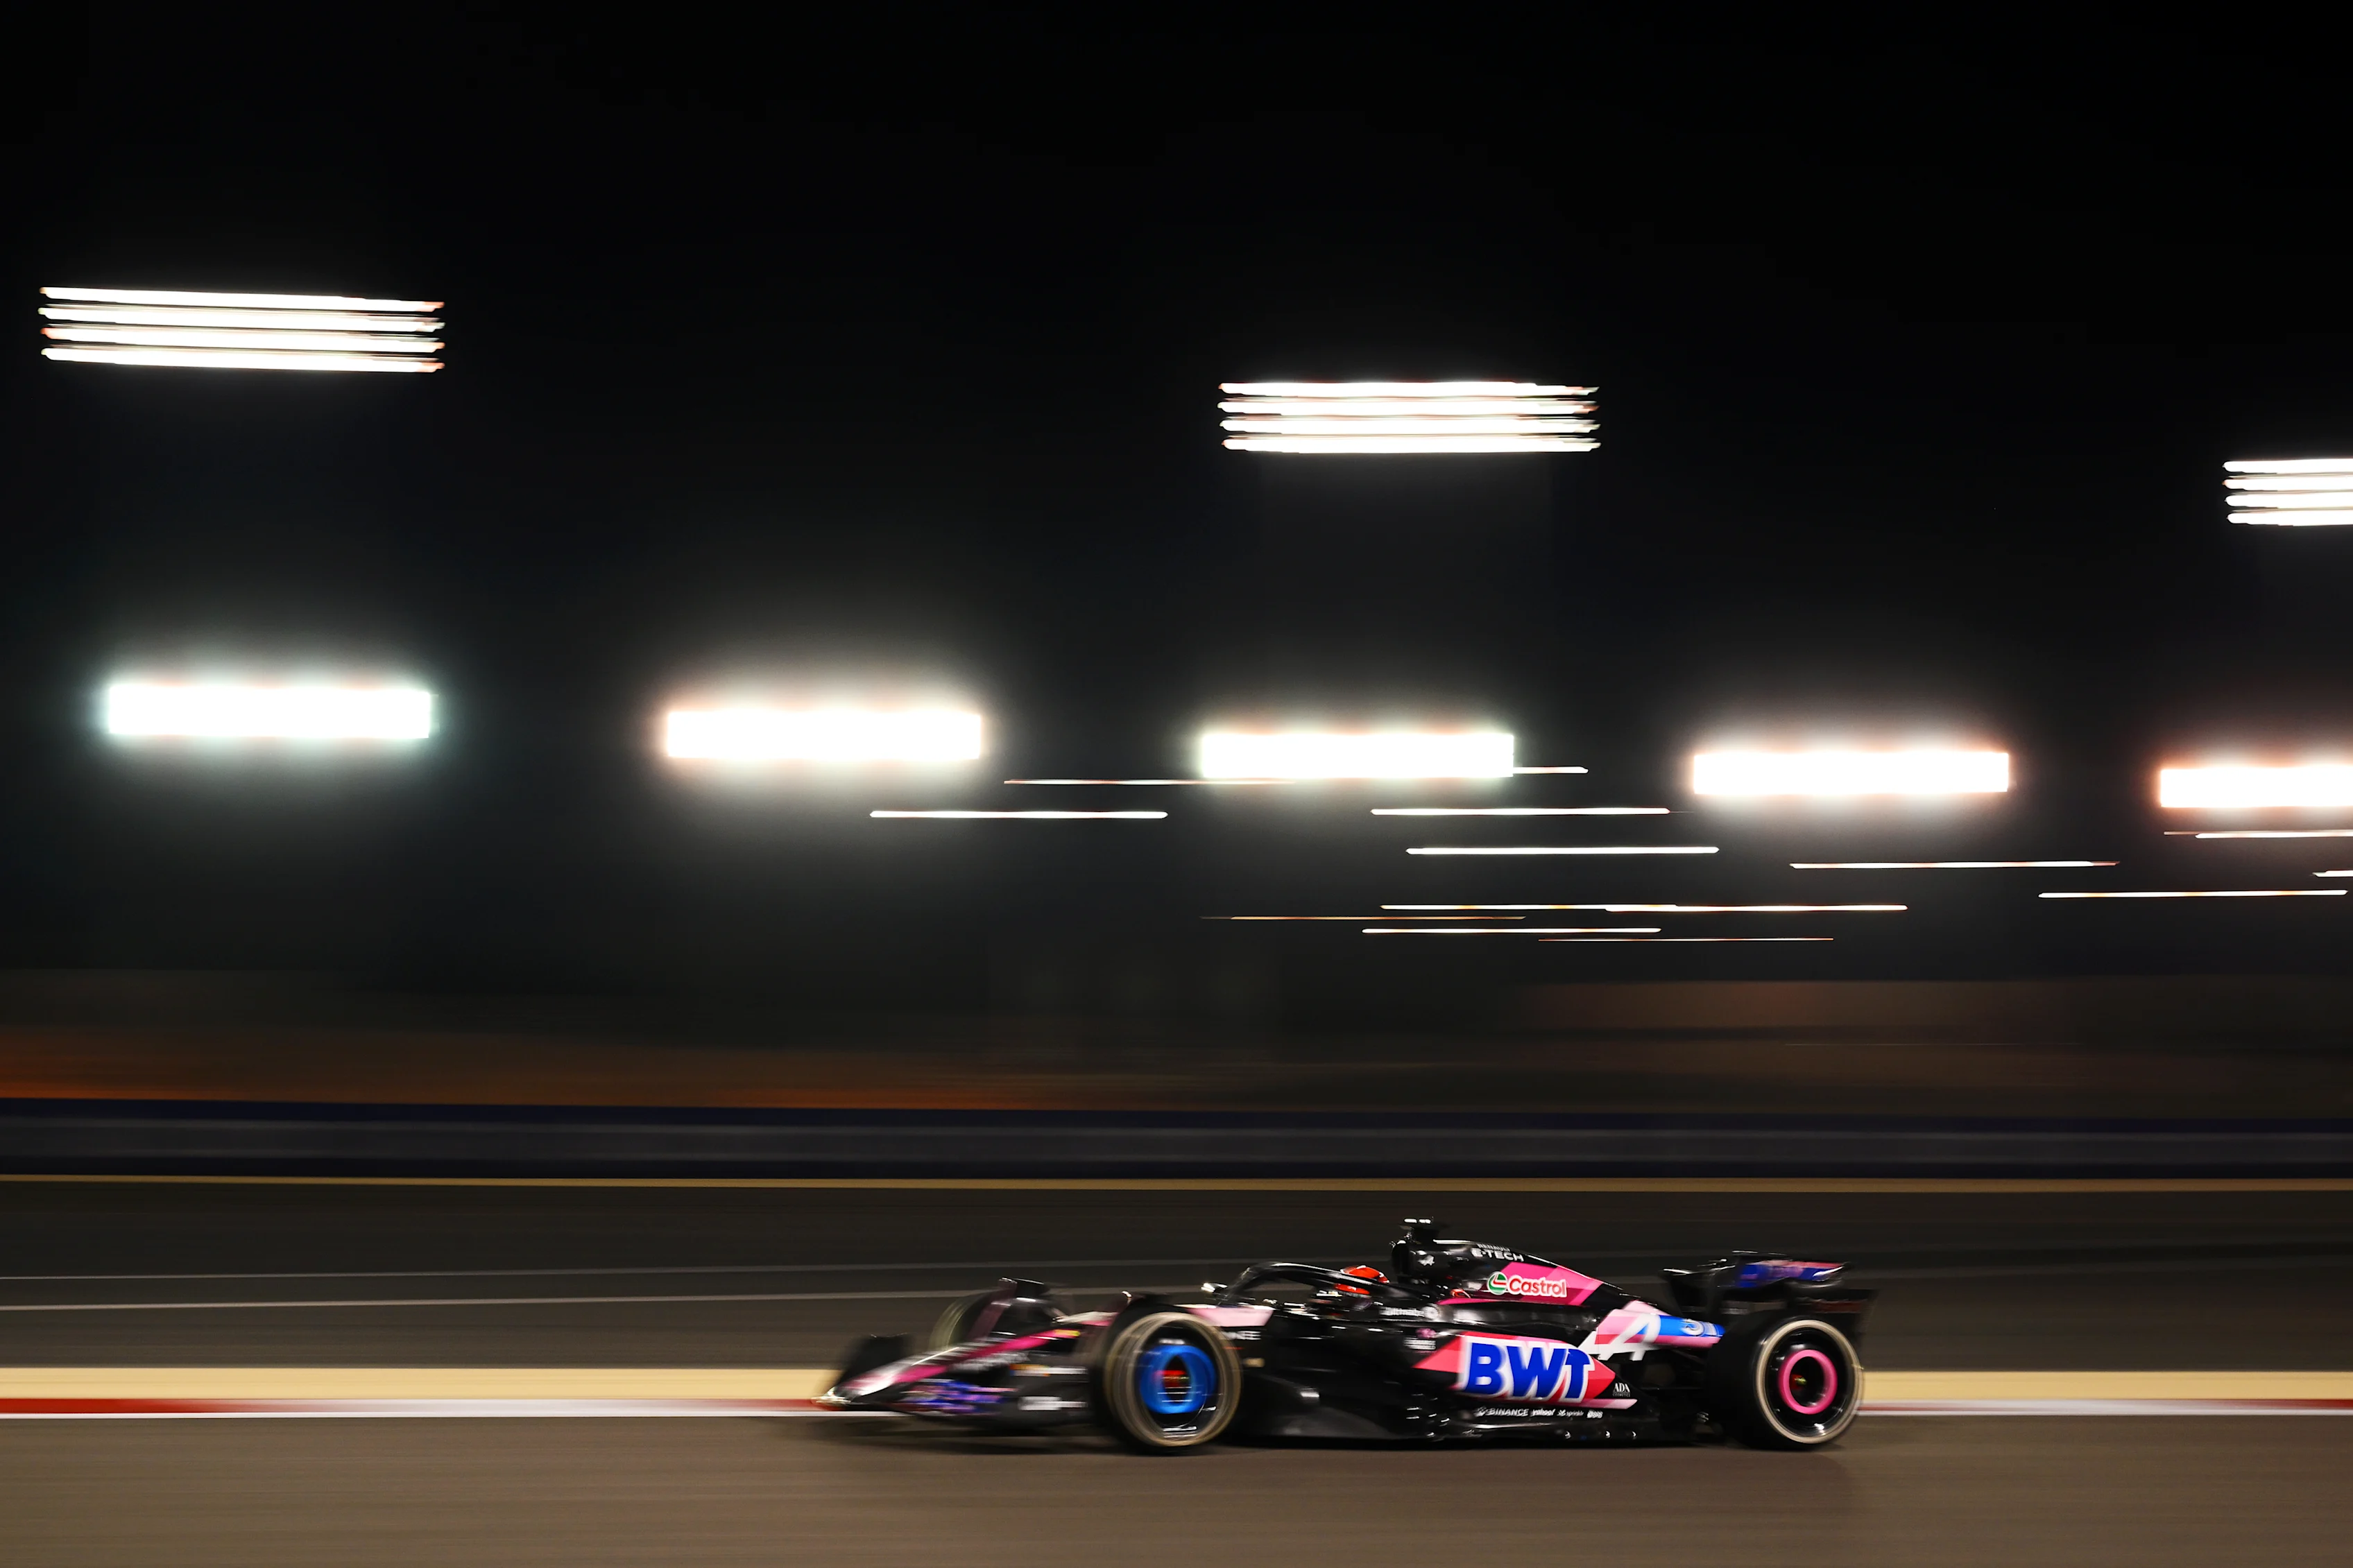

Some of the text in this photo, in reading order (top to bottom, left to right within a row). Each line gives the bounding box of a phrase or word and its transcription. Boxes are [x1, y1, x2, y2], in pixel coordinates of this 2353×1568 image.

[1508, 1275, 1568, 1298] Castrol
[1464, 1342, 1591, 1399] BWT
[1613, 1382, 1631, 1393] ADA
[1486, 1408, 1530, 1417] BINANCE
